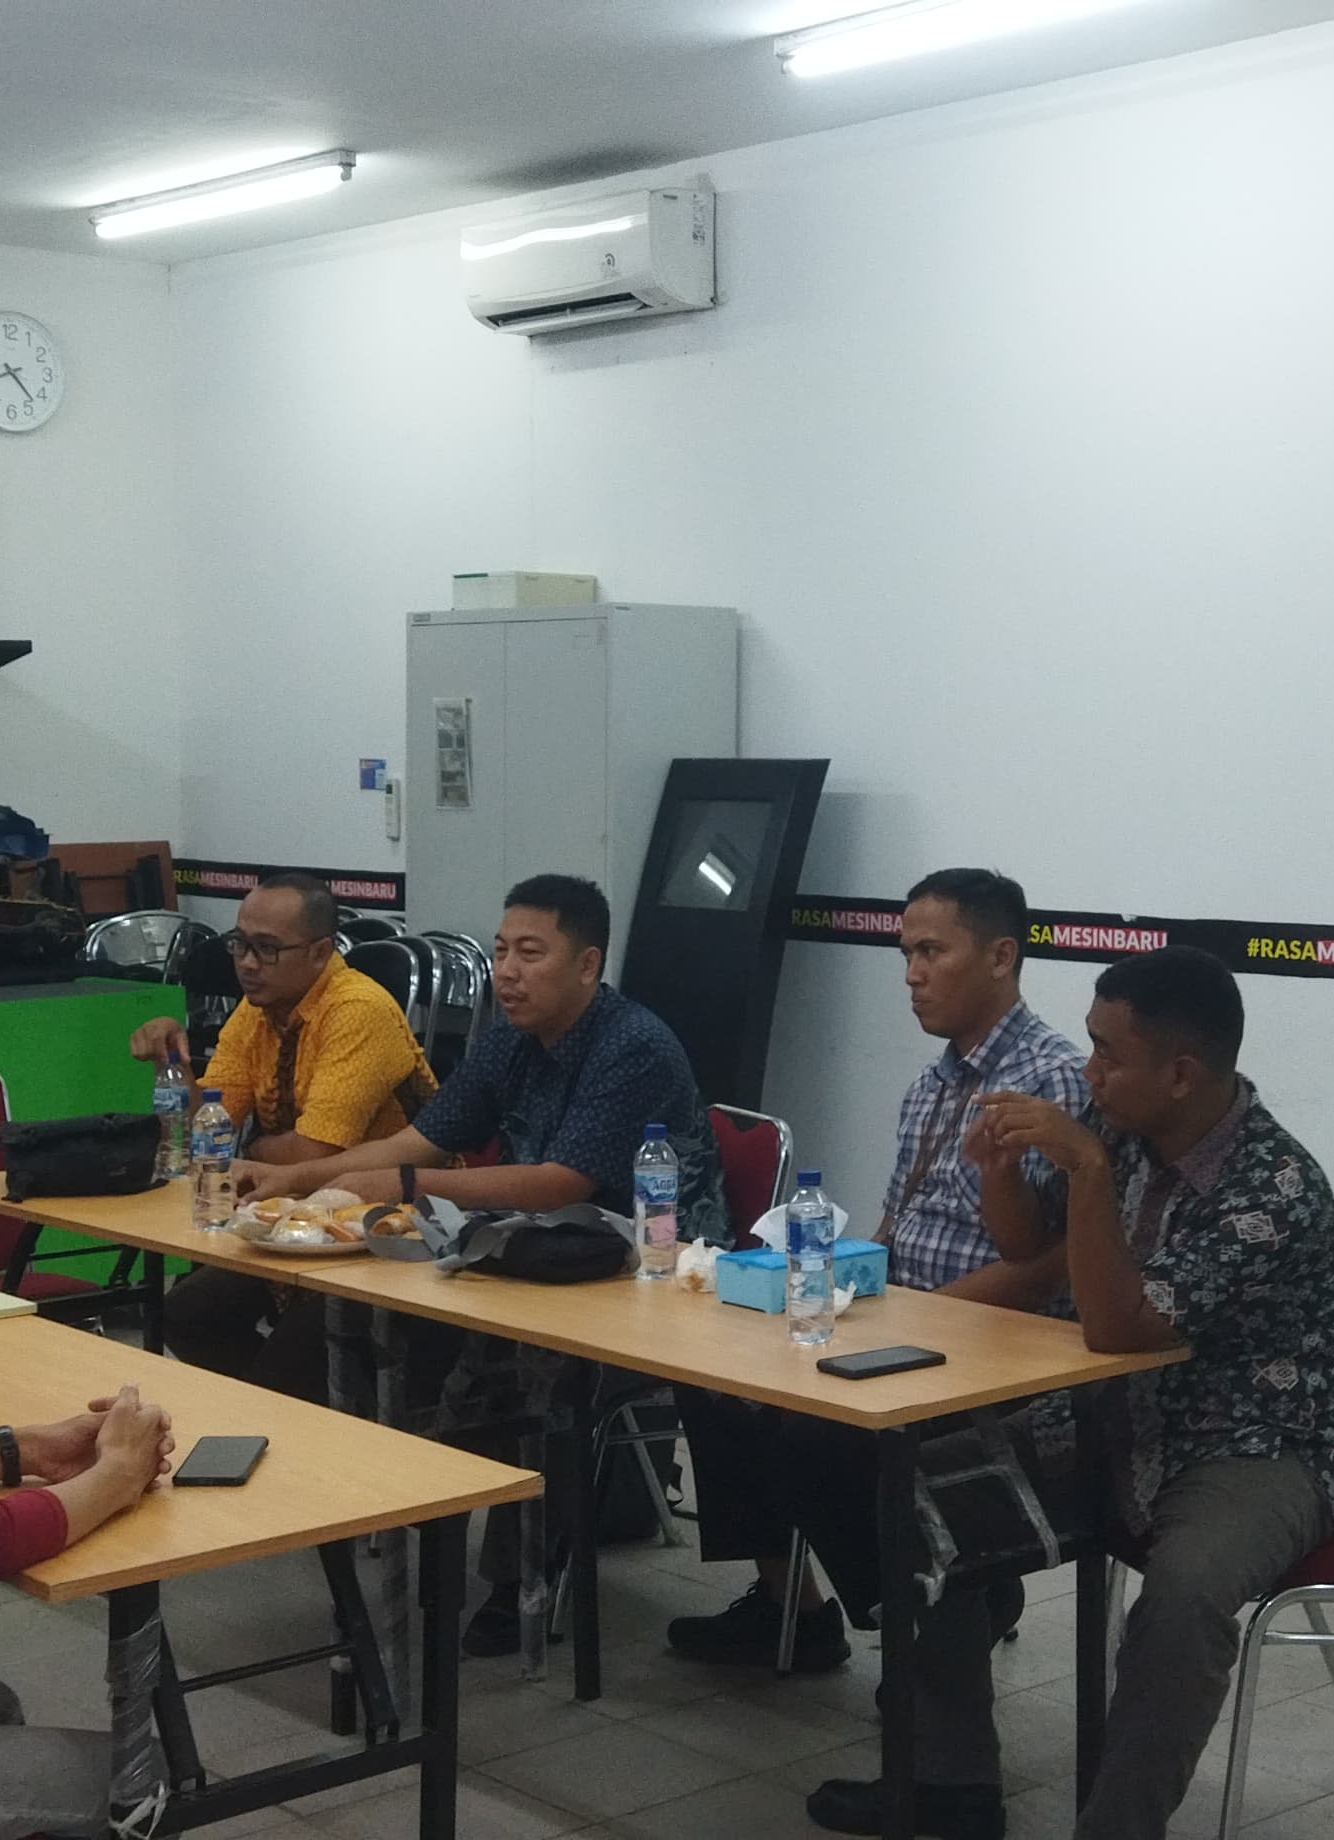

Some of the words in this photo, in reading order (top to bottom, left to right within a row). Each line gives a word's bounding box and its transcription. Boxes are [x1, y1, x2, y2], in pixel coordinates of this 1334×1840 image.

[2, 323, 18, 341] 12
[25, 331, 31, 347] 1
[36, 346, 46, 363] 2
[43, 366, 53, 384] 3
[36, 386, 48, 401] 4
[6, 404, 17, 421] 6
[23, 400, 34, 417] 5
[325, 879, 396, 899] MESINBARU
[792, 908, 903, 935] RASAMESINBA
[1028, 924, 1168, 952] SAMESINBARU
